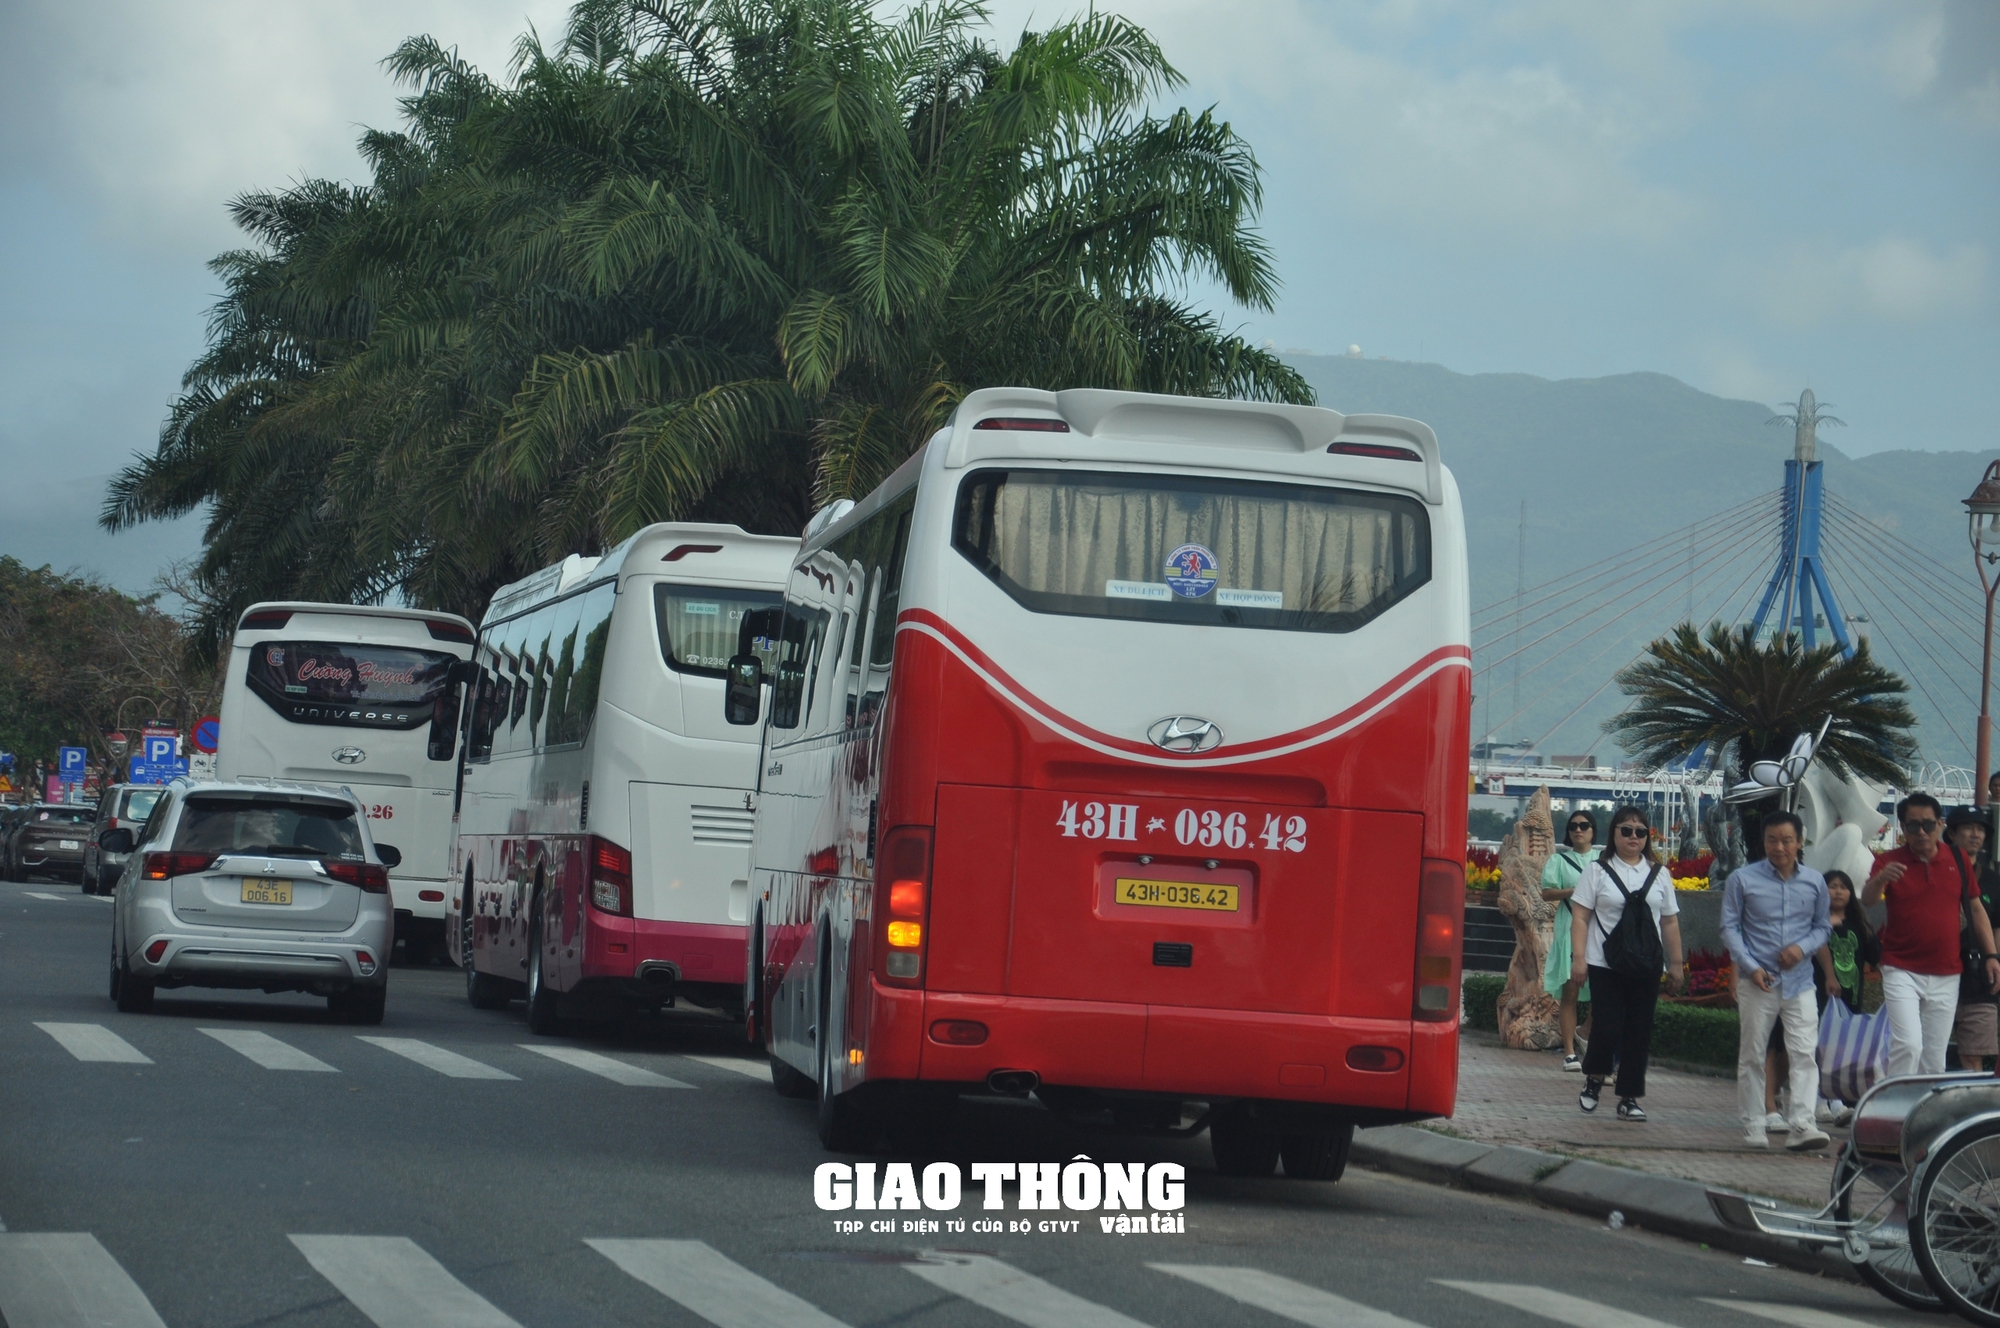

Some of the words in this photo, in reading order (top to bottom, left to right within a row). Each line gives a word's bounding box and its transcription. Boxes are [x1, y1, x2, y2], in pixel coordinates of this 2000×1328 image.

[1113, 586, 1126, 594] XE
[1128, 586, 1141, 594] DU
[1219, 592, 1232, 600] XE
[298, 658, 352, 686] Cường
[356, 661, 416, 688] Huỳnh
[294, 707, 408, 722] UNIVERSE
[66, 750, 82, 769] P
[152, 740, 170, 762] P
[1056, 799, 1140, 842] 43H
[256, 880, 278, 890] 43E
[247, 890, 286, 902] 006.16
[1126, 884, 1228, 906] 43H-036.42
